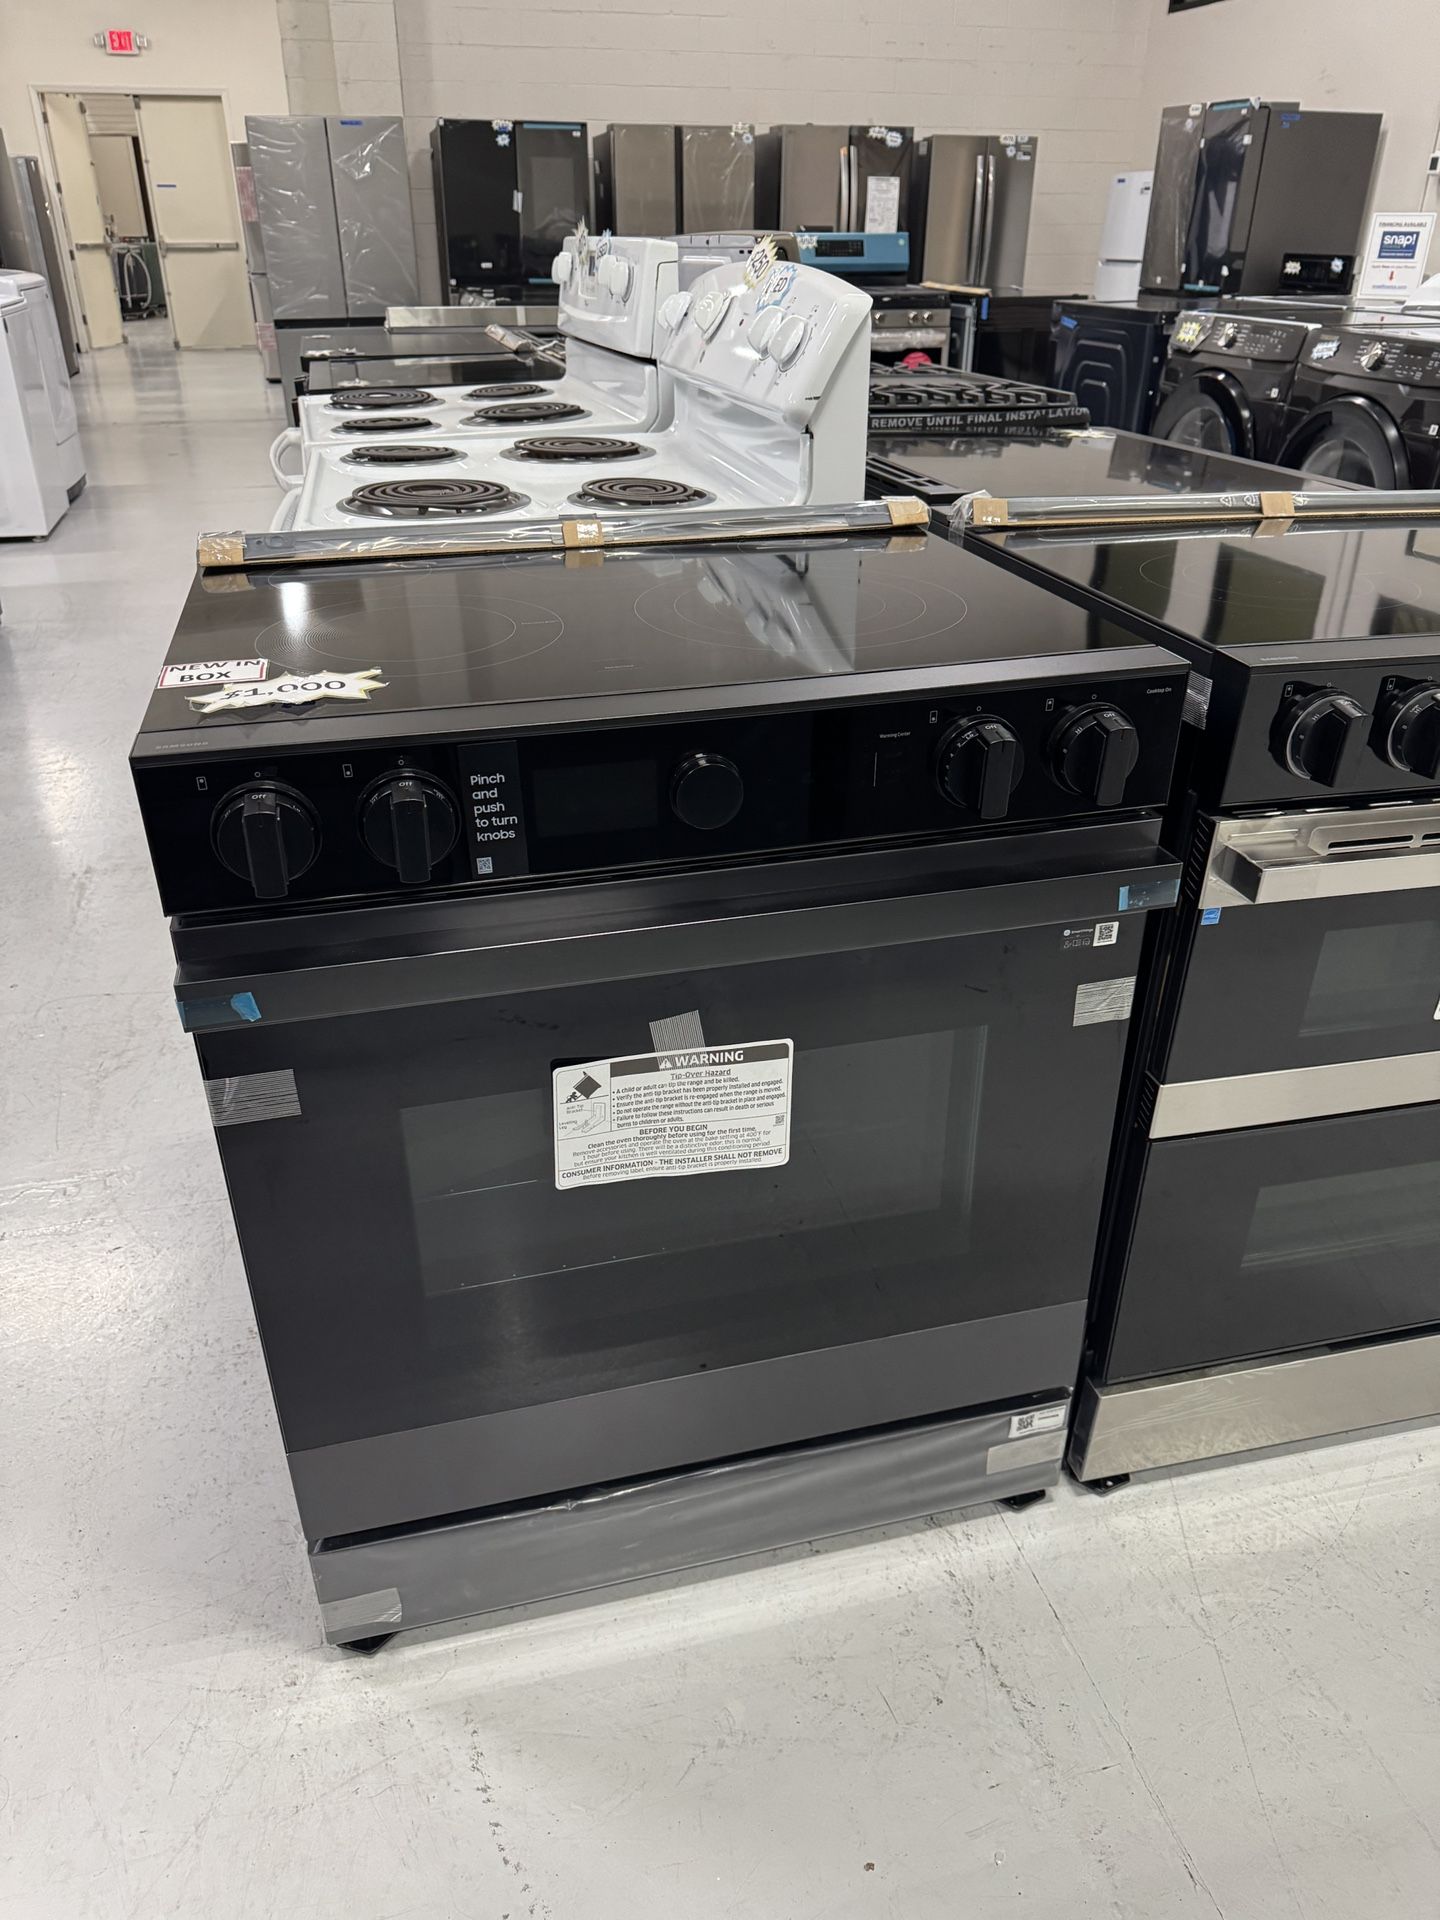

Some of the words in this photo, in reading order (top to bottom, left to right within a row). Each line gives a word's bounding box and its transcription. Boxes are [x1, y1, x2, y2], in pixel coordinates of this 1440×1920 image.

[1383, 234, 1417, 248] snap!
[872, 418, 922, 428] REMOVE
[927, 416, 963, 426] UNTIL
[967, 415, 1002, 424] FINAL
[170, 662, 228, 673] NEW
[180, 671, 231, 682] BOX
[220, 680, 346, 700] $1,000
[470, 773, 505, 785] Pinch
[472, 788, 498, 799] and
[474, 802, 505, 817] push
[475, 818, 489, 827] to
[491, 816, 518, 826] turn
[477, 830, 516, 842] knobs
[675, 1050, 744, 1067] WARNING
[670, 1071, 703, 1080] Tip-Over
[706, 1084, 728, 1092] properly
[633, 1134, 666, 1143] thoroughly
[596, 1144, 627, 1153] accessories
[562, 1167, 601, 1179] CONSUMER
[603, 1160, 653, 1171] INFORMATION
[675, 1156, 712, 1164] INSTALLER
[714, 1152, 736, 1160] SHALL
[753, 1147, 782, 1157] REMOVE
